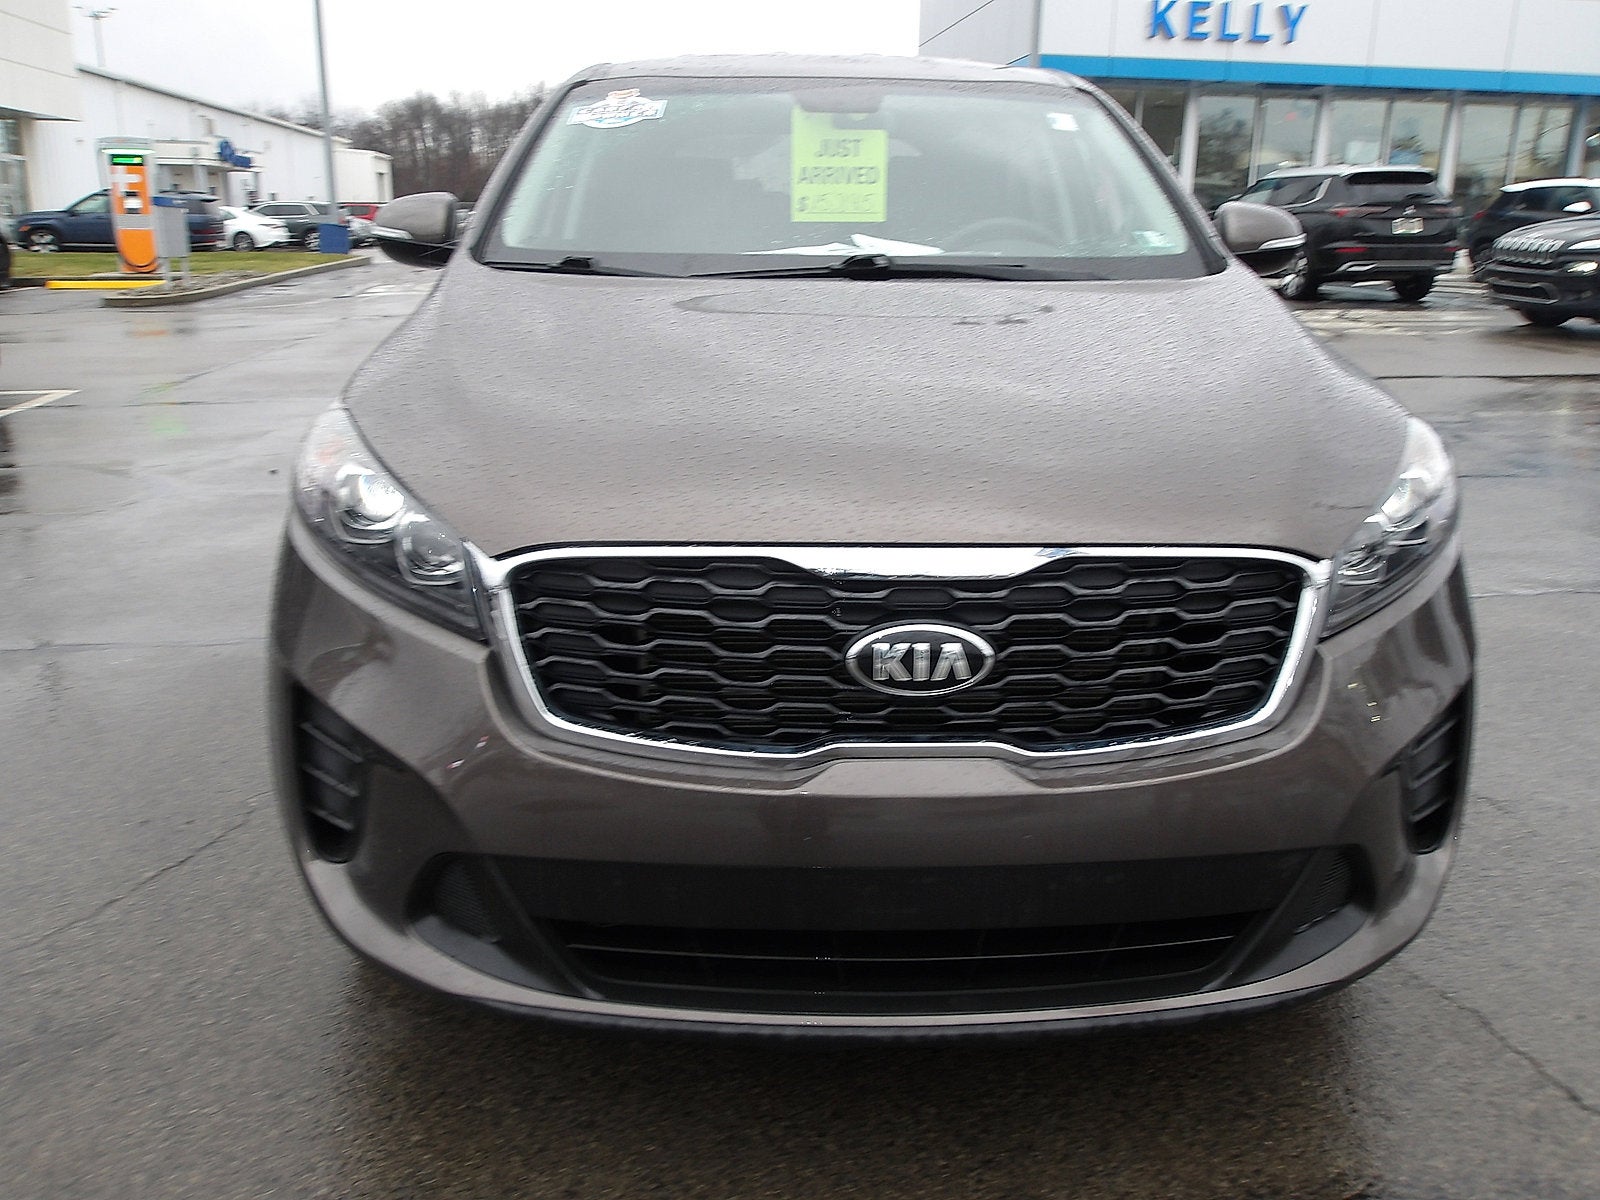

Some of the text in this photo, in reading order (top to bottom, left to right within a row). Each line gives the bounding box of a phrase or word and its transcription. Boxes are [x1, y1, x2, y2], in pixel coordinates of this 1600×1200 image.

[1148, 0, 1307, 44] KELLY
[815, 138, 862, 157] JUST
[797, 166, 879, 184] ARRIVED
[871, 642, 972, 682] KIA
